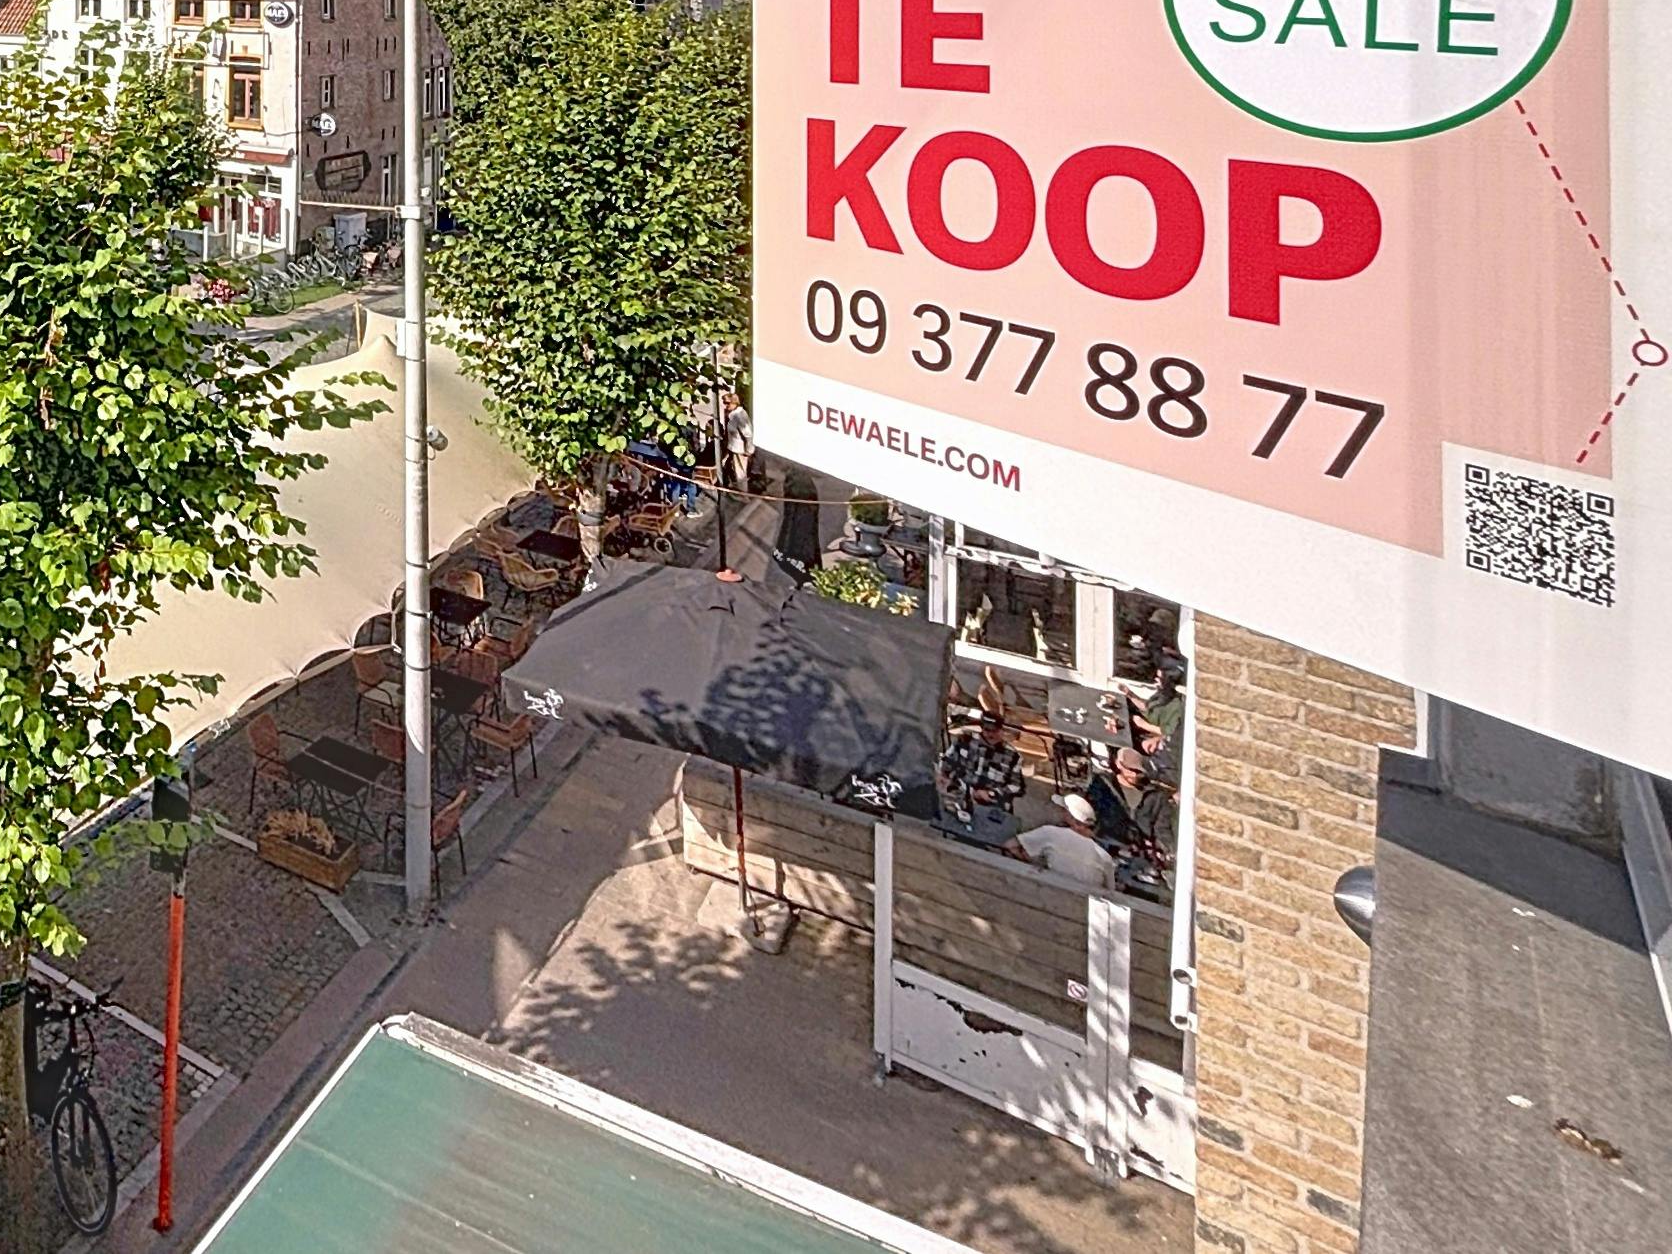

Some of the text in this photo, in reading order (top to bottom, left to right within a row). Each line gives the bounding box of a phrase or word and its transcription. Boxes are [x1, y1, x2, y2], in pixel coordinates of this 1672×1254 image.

[805, 117, 1383, 327] KOOP
[806, 280, 1386, 479] 09 377 88 77
[806, 401, 1022, 493] DEWAELE.COM
